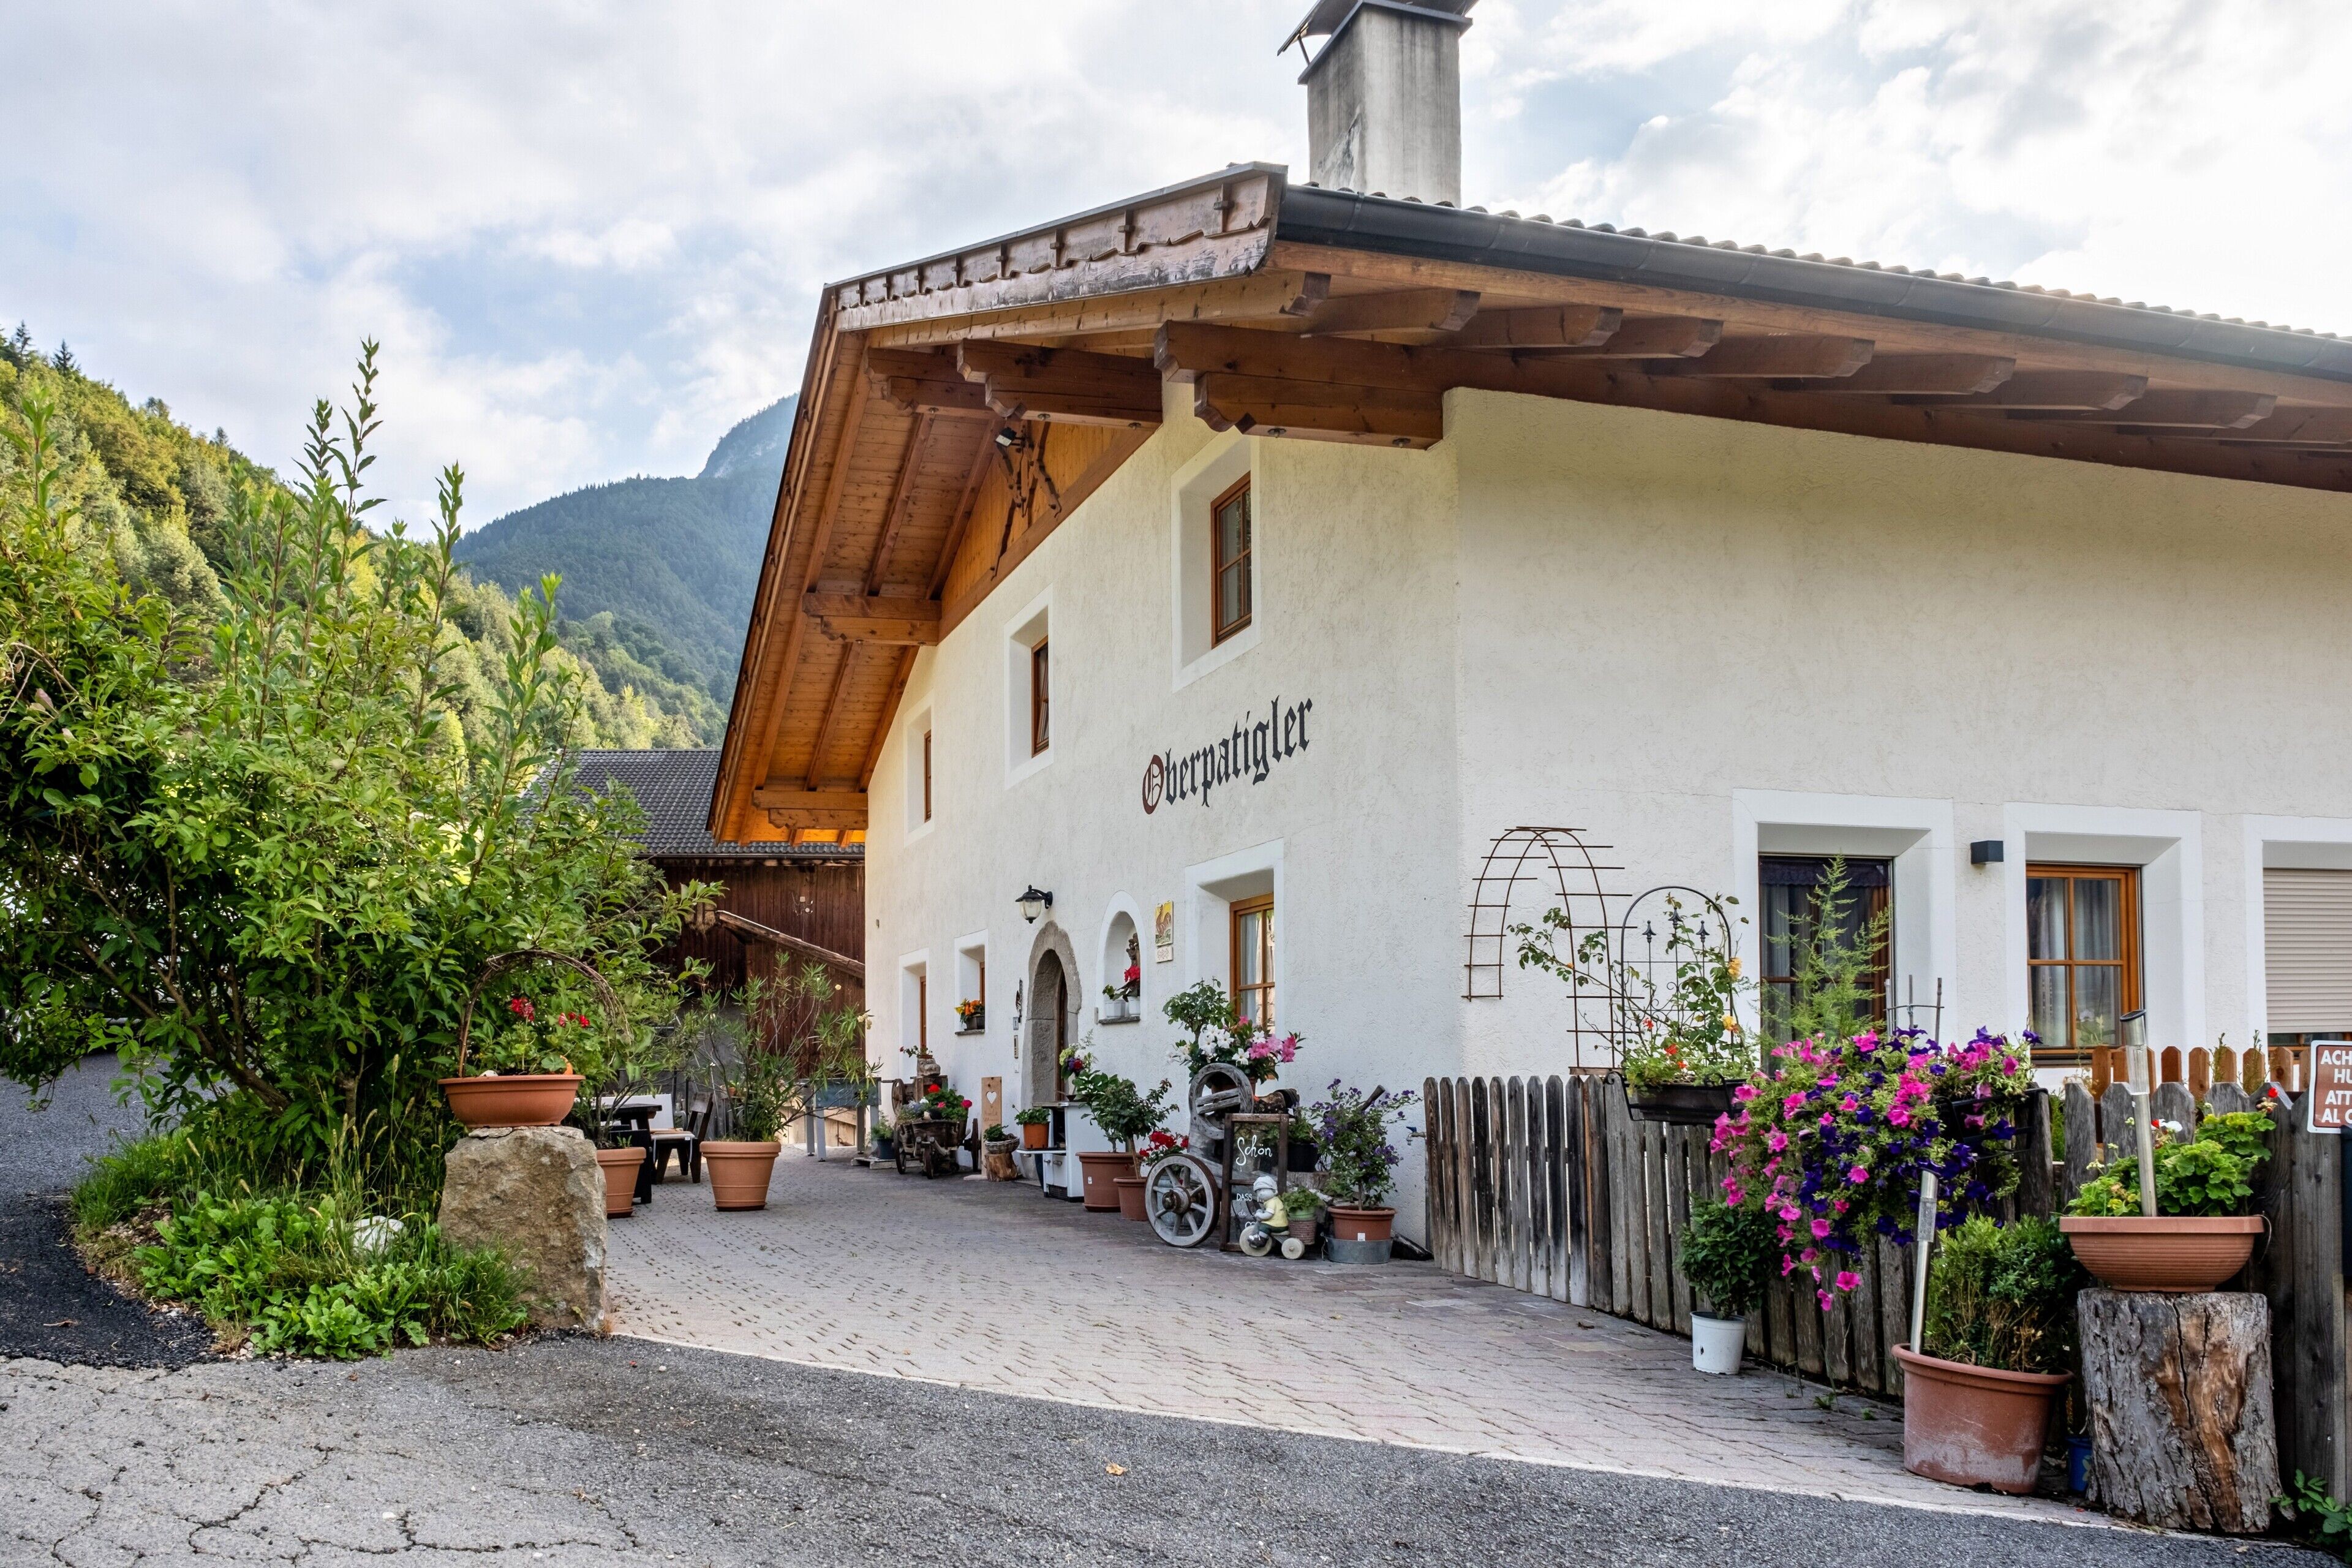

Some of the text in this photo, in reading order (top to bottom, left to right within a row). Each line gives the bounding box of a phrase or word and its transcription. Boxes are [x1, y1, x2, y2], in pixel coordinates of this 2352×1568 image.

[1142, 695, 1313, 815] Oberpatigler
[2320, 1050, 2352, 1065] ACH
[2324, 1090, 2352, 1105] ATT
[2321, 1108, 2341, 1123] AL
[1236, 1134, 1272, 1166] Schön
[1236, 1193, 1253, 1202] DASS
